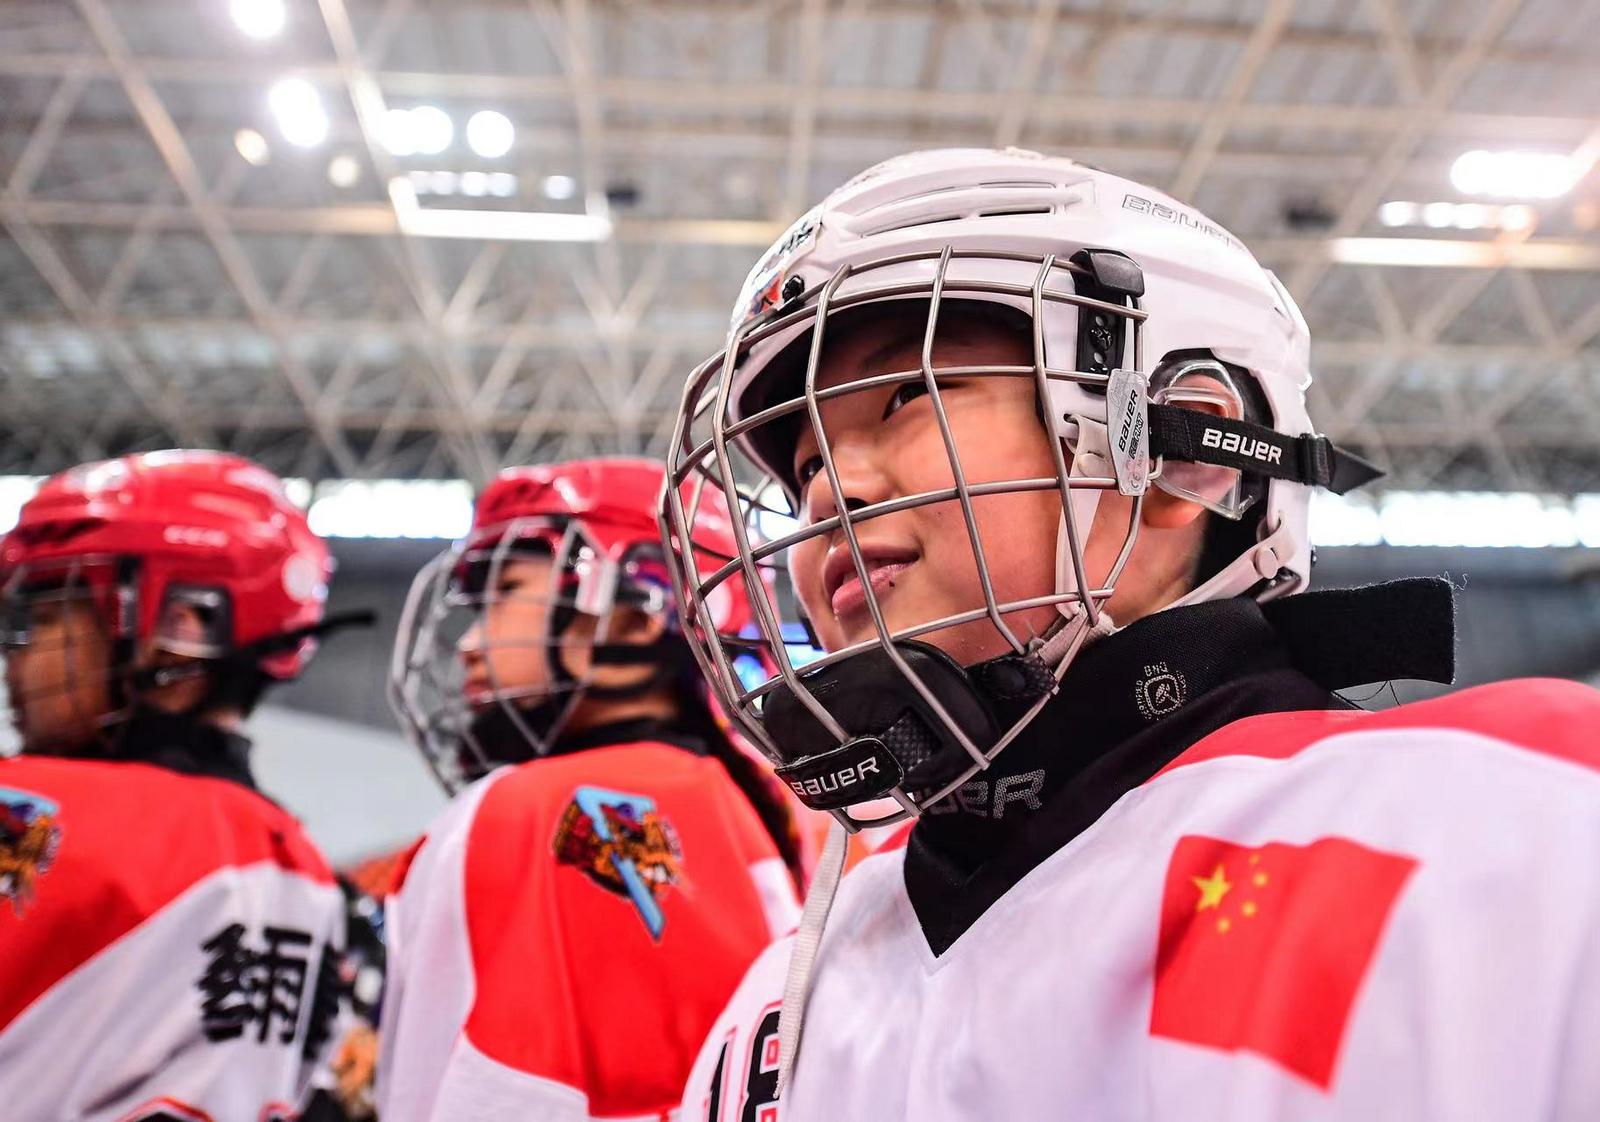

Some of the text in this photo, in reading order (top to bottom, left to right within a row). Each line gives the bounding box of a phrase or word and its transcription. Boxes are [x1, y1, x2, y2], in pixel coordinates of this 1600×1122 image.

[1119, 389, 1138, 452] BAUER
[1202, 428, 1283, 465] BAUER
[790, 756, 880, 797] BAUER
